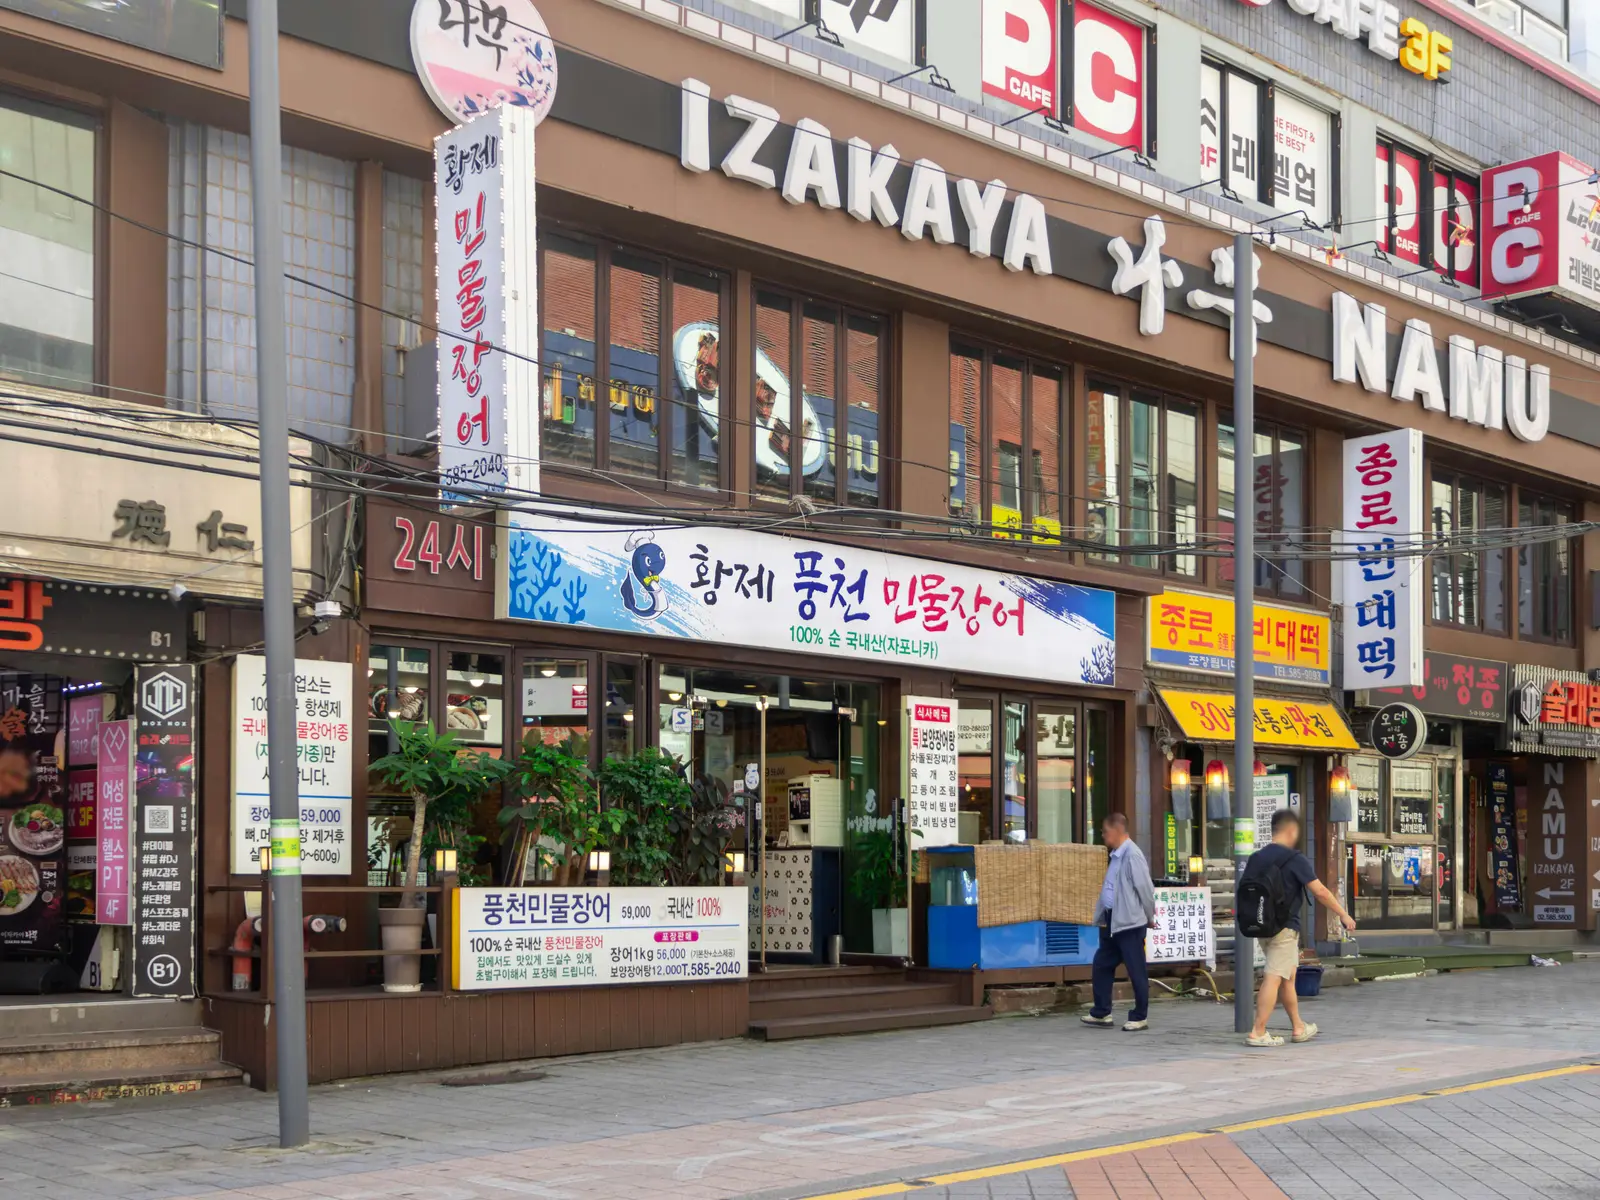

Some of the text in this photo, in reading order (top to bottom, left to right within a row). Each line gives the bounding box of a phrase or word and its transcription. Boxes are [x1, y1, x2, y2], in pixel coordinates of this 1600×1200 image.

[1400, 17, 1452, 81] 3F
[1009, 76, 1052, 108] CAFE
[1285, 120, 1309, 141] FIRST
[1309, 131, 1316, 143] &
[1285, 136, 1306, 153] BEST
[444, 134, 498, 195] 황제
[681, 77, 1053, 277] IZAKAYA
[1514, 211, 1541, 226] CAFE
[1395, 235, 1419, 255] CAFE
[452, 190, 494, 446] 민물장어
[1332, 291, 1550, 442] NAMU
[394, 516, 484, 581] 24시
[690, 543, 1025, 637] 황제 풍천 민물장어
[1160, 603, 1214, 649] 종로
[151, 631, 172, 647] B1
[789, 626, 939, 661] 100% 순 국내산(자포니카)
[1452, 663, 1501, 709] 정종
[305, 698, 341, 718] 항생제
[917, 707, 949, 719] 식사메뉴
[1284, 704, 1335, 738] 맛집
[922, 728, 956, 752] 보양장어탕
[911, 752, 956, 765] 차돌된장찌개
[102, 780, 124, 803] 여성
[911, 785, 956, 797] 고등어조림
[79, 806, 94, 827] 3F
[102, 807, 124, 832] 전문
[1542, 762, 1566, 860] NAMU
[313, 829, 345, 844] 제거후
[102, 838, 125, 862] 헬스
[159, 855, 179, 865] #DJ
[1533, 863, 1575, 875] IZAKAYA
[1560, 878, 1575, 889] 2F
[1160, 891, 1198, 903] 특선메뉴
[105, 899, 120, 919] 4F
[482, 892, 722, 926] 풍천민물장어 59,000 국내산 100%
[1167, 904, 1206, 917] 생삼겹살
[142, 935, 165, 945] #회식
[469, 935, 604, 953] 100% 순 국내산 풍천민물장어
[1167, 932, 1207, 944] 보리굴비
[477, 953, 593, 968] 집에서도 맛있게 드실수 있게
[610, 946, 654, 963] 장어1kg
[1153, 945, 1207, 959] 소고기육전
[152, 962, 175, 978] B1
[476, 966, 598, 982] 초벌구이해서 포장해 드립니다.
